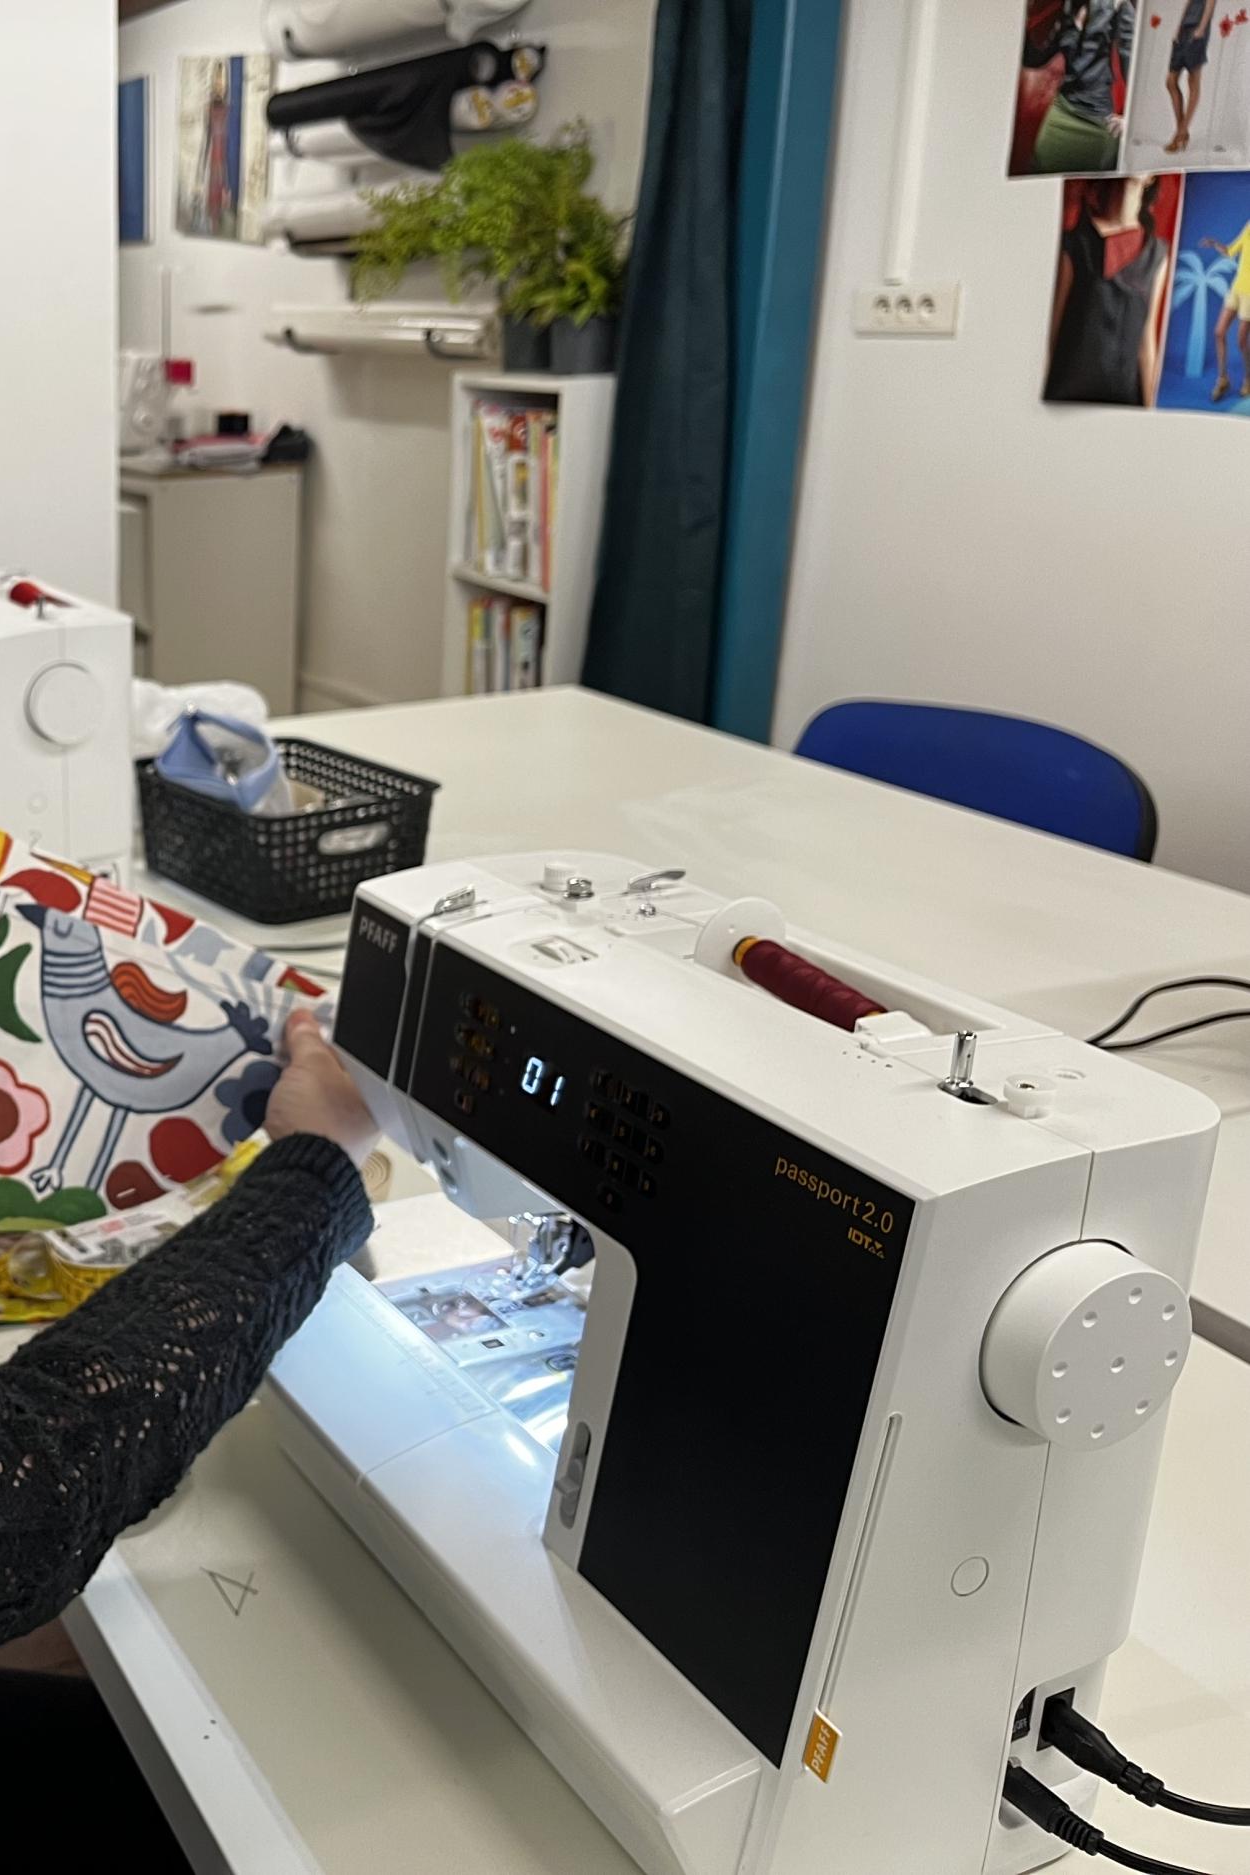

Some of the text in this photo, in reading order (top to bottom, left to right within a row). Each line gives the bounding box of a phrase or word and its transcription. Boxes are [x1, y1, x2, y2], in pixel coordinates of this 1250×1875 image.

[359, 915, 398, 954] PFAFF
[521, 1056, 563, 1106] 01
[810, 1724, 832, 1773] PFAFF
